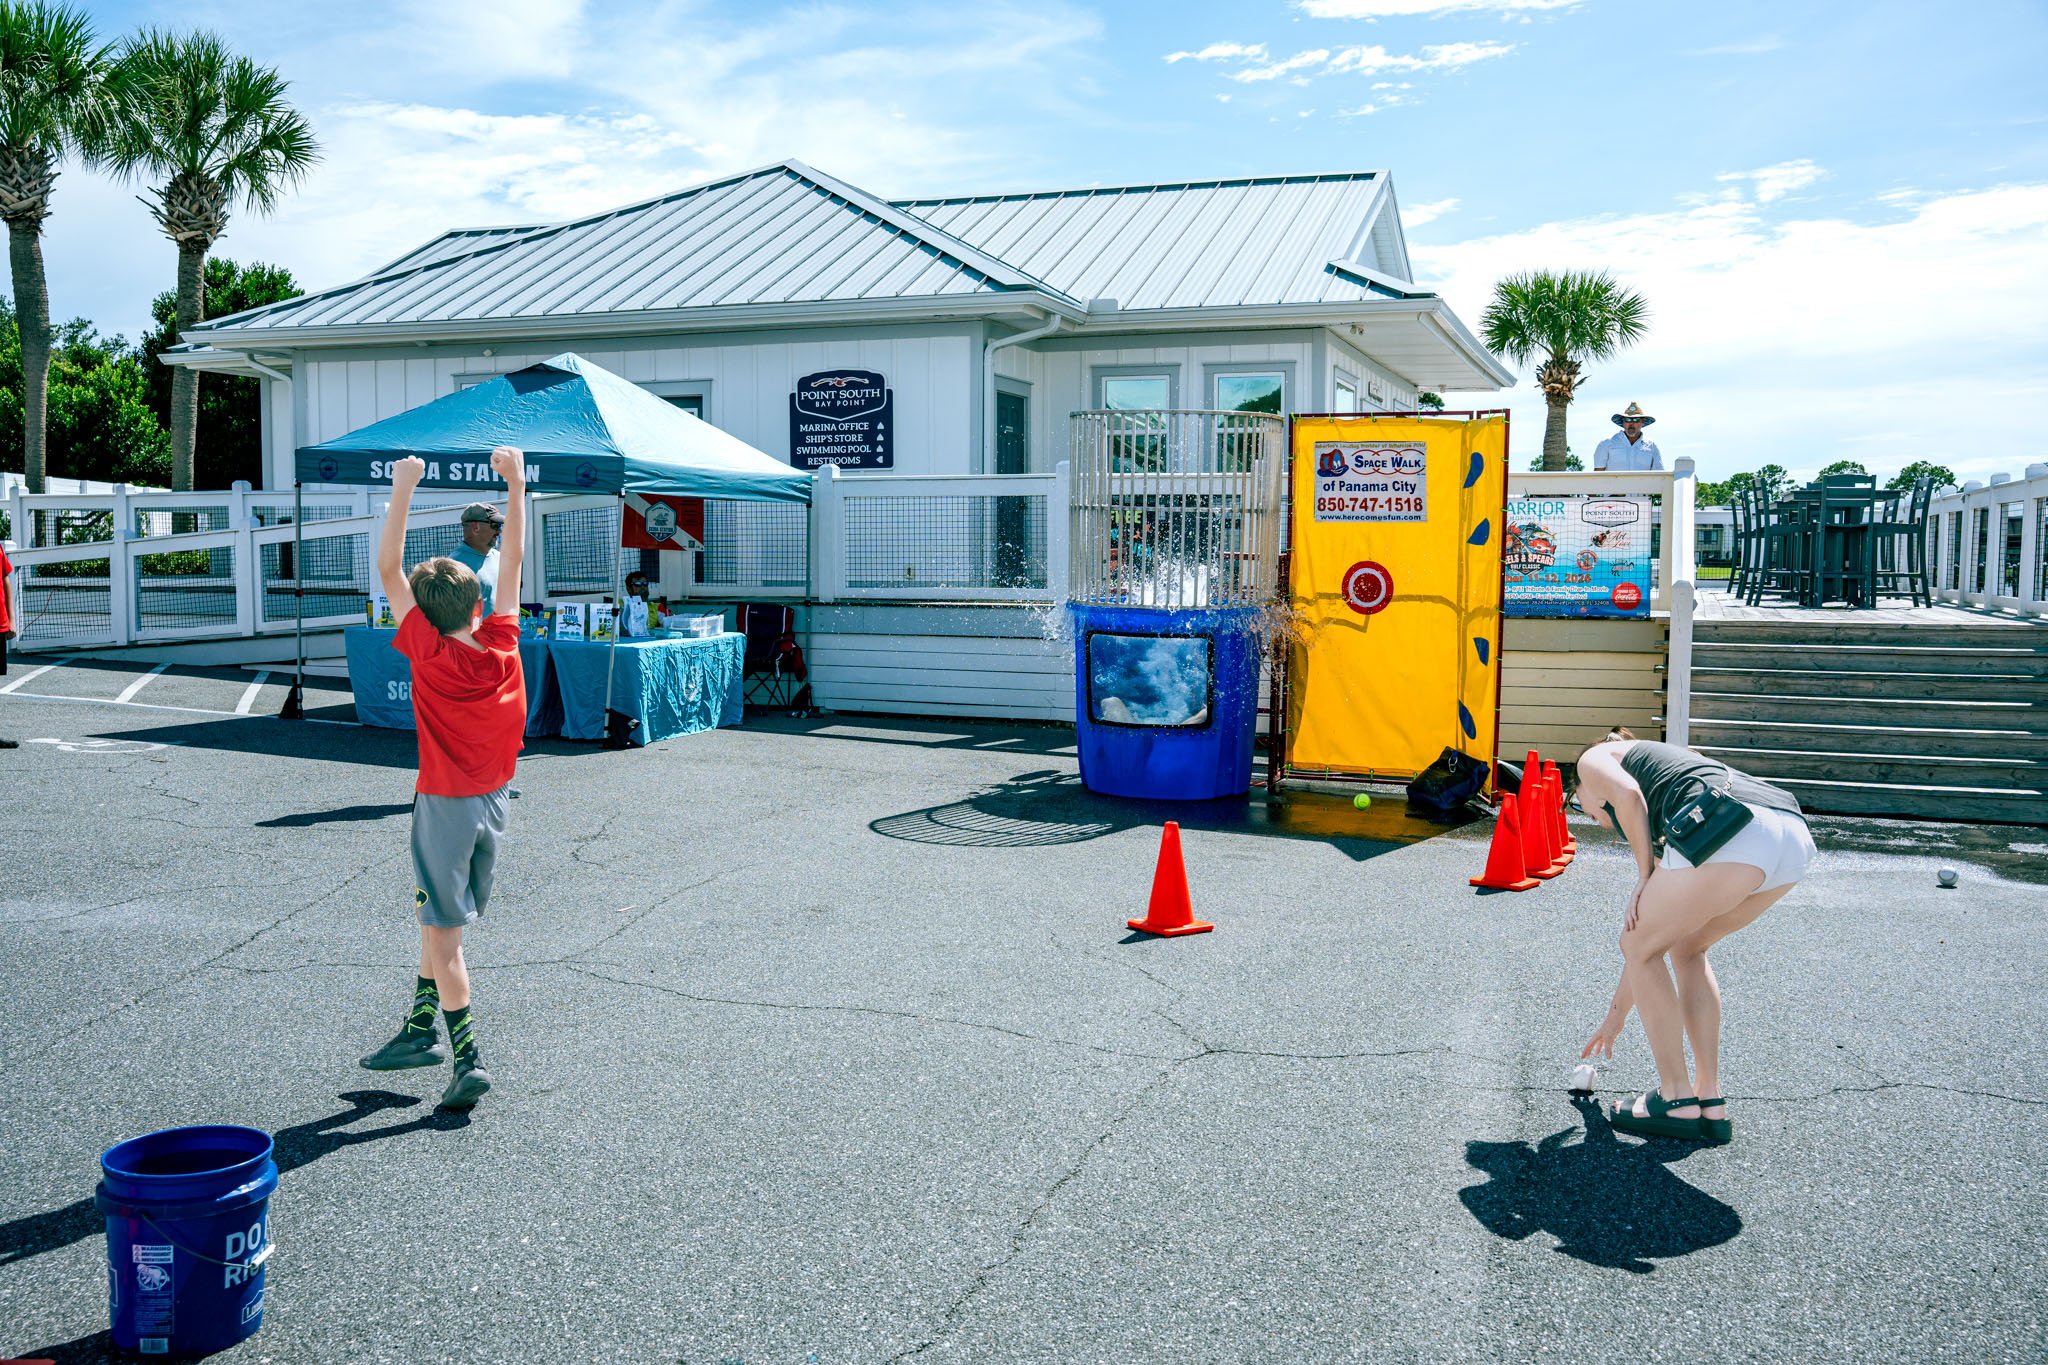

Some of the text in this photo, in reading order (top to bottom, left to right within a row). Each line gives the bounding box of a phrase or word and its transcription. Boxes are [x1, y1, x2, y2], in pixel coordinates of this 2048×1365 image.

[801, 388, 881, 400] POINT SOUTH
[815, 399, 866, 408] BAY POINT
[799, 422, 870, 432] MARINA OFFICE
[805, 433, 864, 444] SHIP'S STORE
[796, 444, 872, 455] SWIMMING POOL
[807, 456, 861, 465] RESTROOMS
[1354, 454, 1421, 468] SPACE WALK
[370, 460, 540, 483] SCA STATN
[1322, 480, 1417, 495] of Panama City
[1317, 497, 1423, 512] 850-747-1518
[1111, 511, 1142, 523] FEE
[1527, 553, 1555, 566] SPEARS
[1564, 573, 1591, 584] 2026
[564, 605, 577, 615] TRY
[225, 1222, 262, 1261] DO
